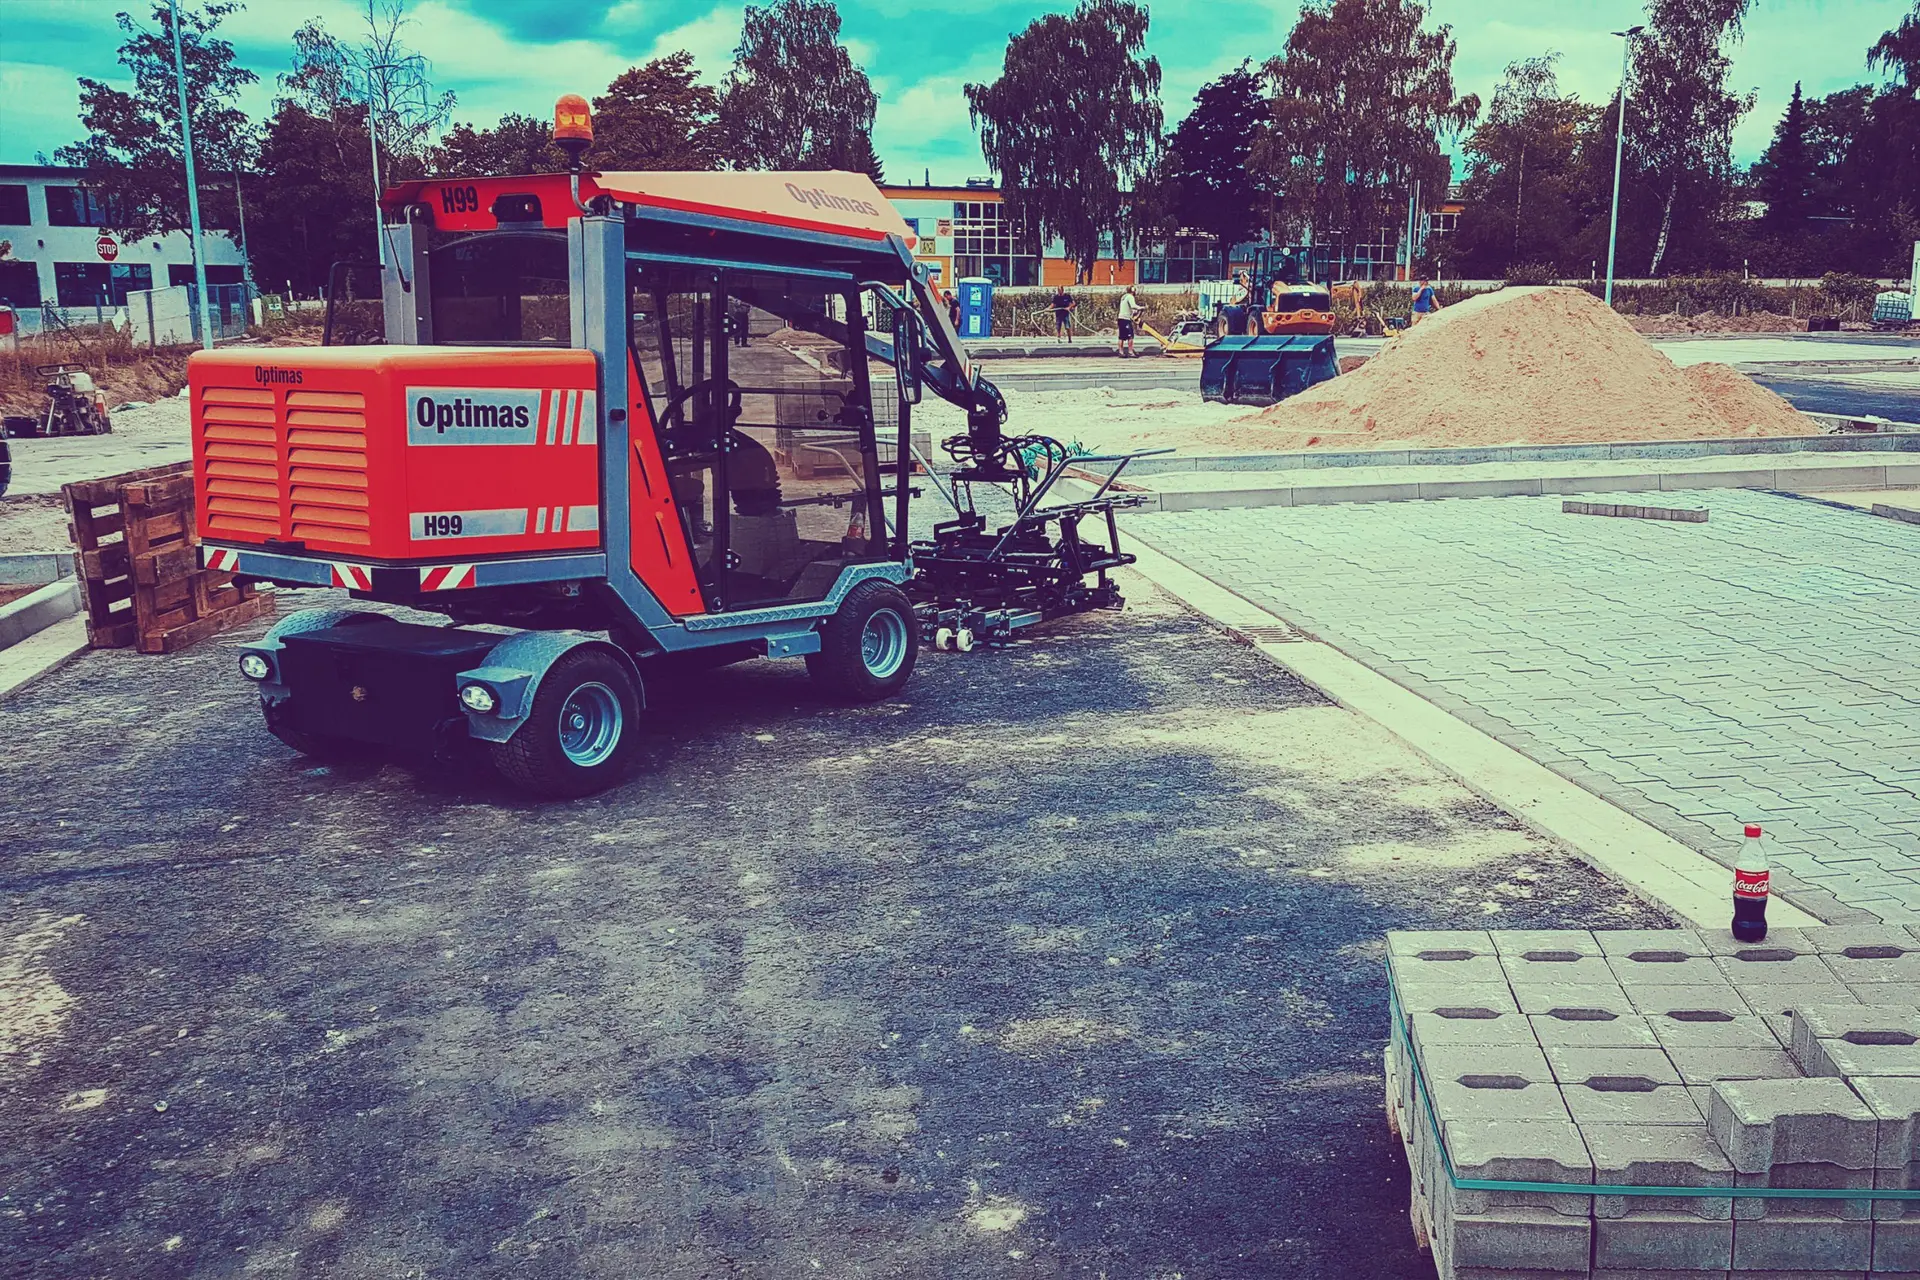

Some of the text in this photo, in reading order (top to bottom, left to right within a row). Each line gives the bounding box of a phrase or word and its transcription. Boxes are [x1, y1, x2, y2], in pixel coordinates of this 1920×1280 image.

[440, 185, 479, 214] H99
[784, 182, 880, 217] Optimas
[98, 244, 117, 255] STOP
[255, 365, 303, 387] Optimas
[416, 396, 530, 434] Optimas
[423, 514, 463, 537] H99
